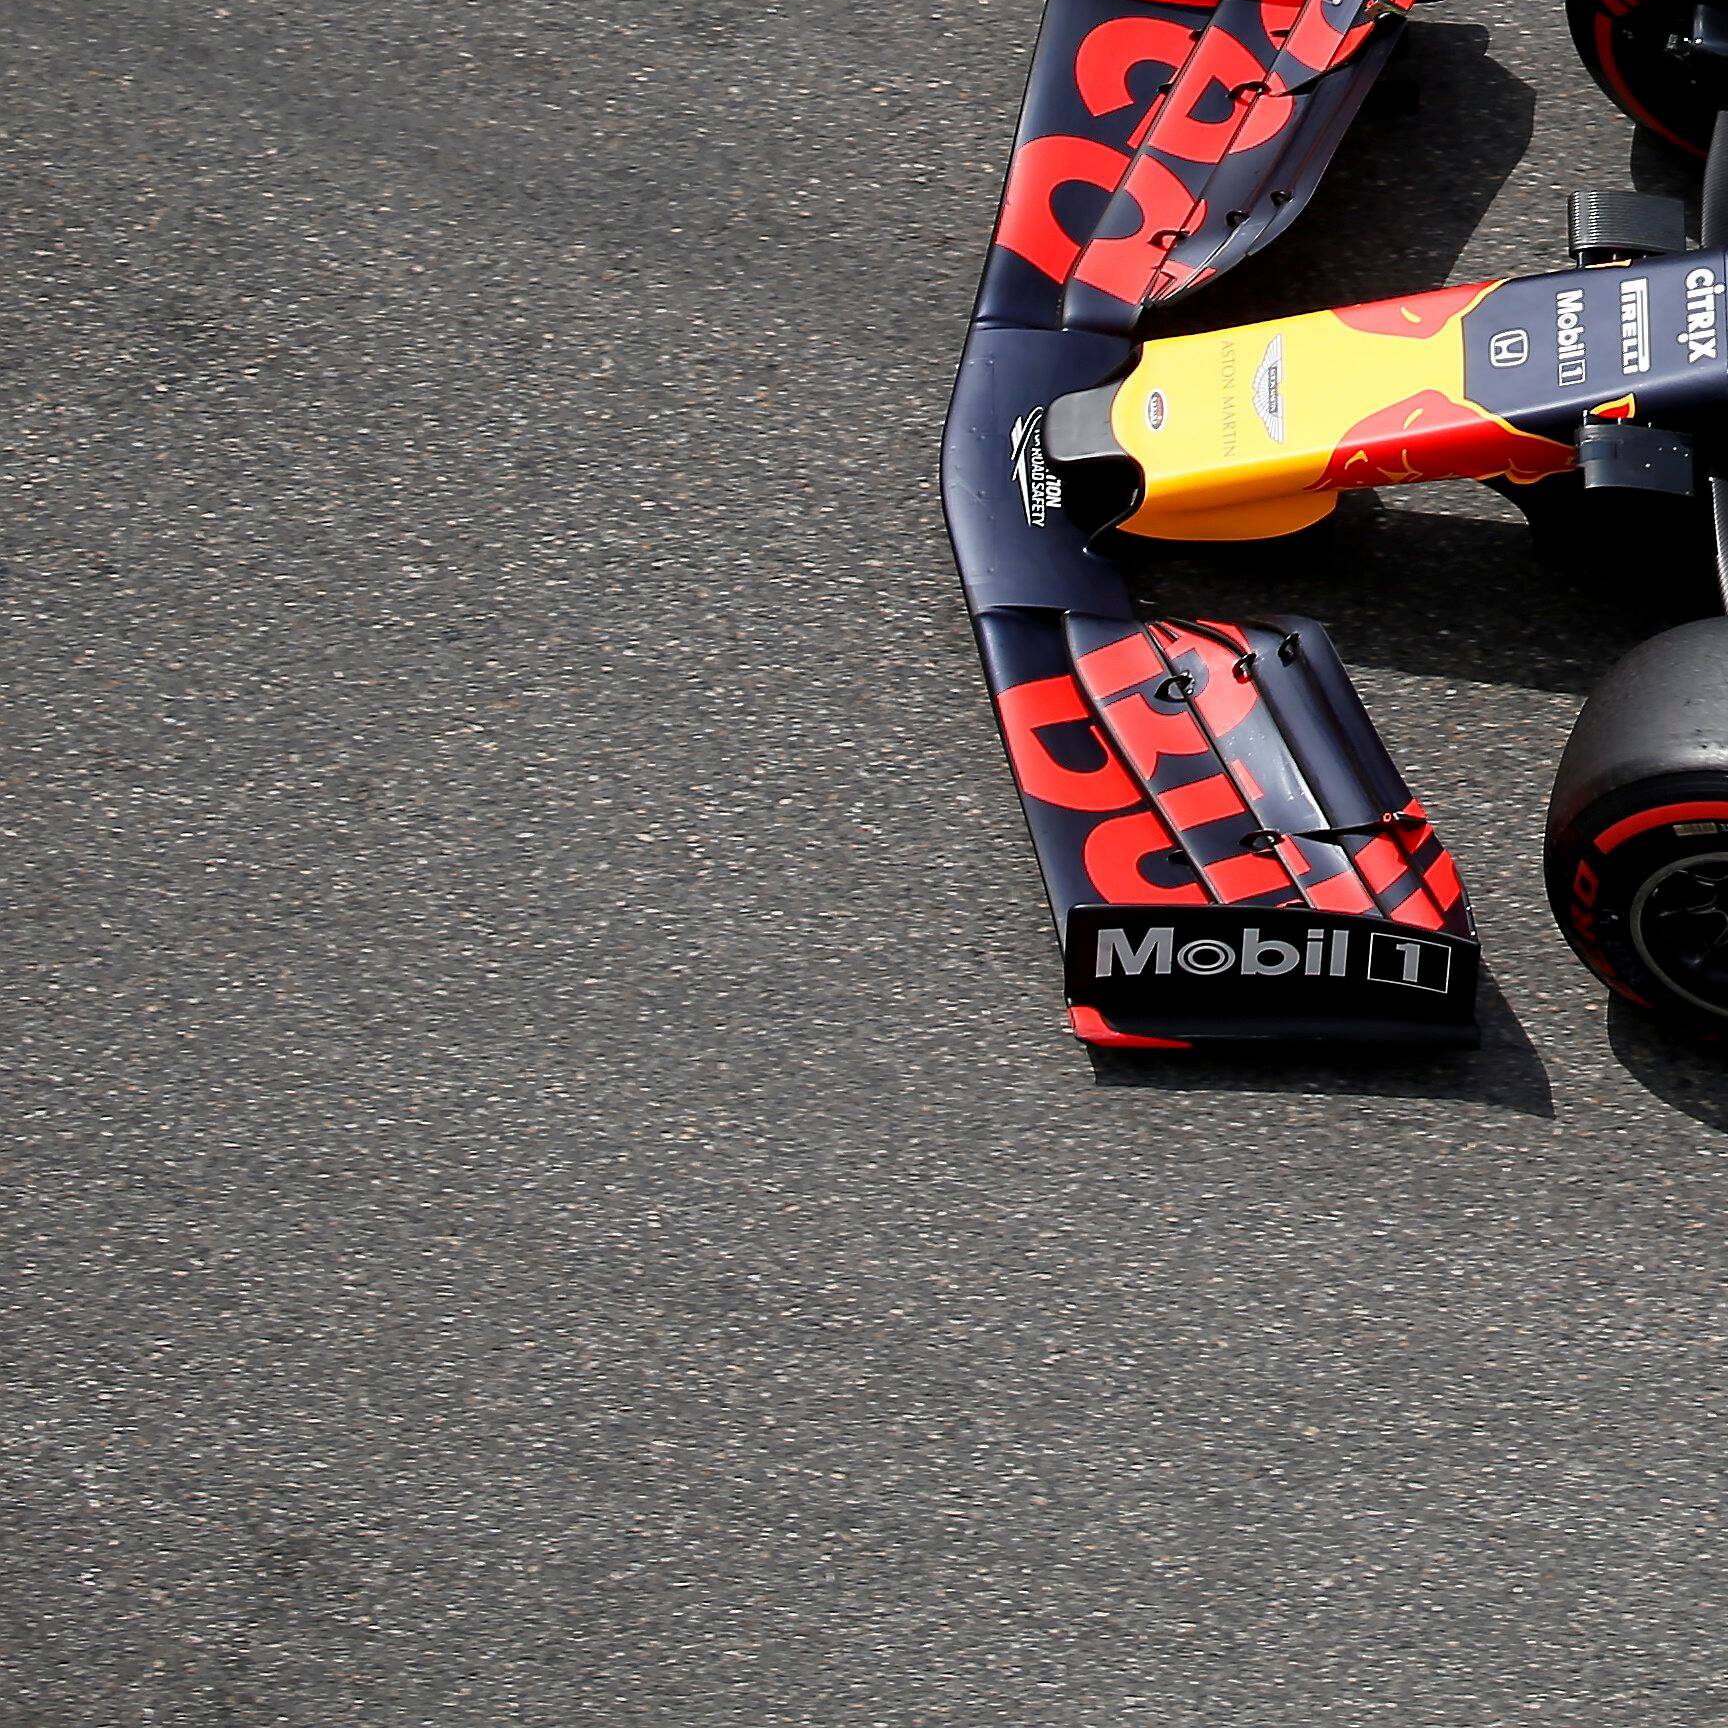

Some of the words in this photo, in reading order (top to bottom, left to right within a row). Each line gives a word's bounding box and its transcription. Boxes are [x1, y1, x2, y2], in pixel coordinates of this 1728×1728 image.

[1556, 289, 1586, 360] Mobil
[1620, 277, 1650, 375] PIRELLI
[1221, 339, 1237, 390] ASTON
[1221, 395, 1238, 458] MARTIN
[1031, 481, 1045, 528] SAFETY
[1094, 925, 1350, 980] Mobil
